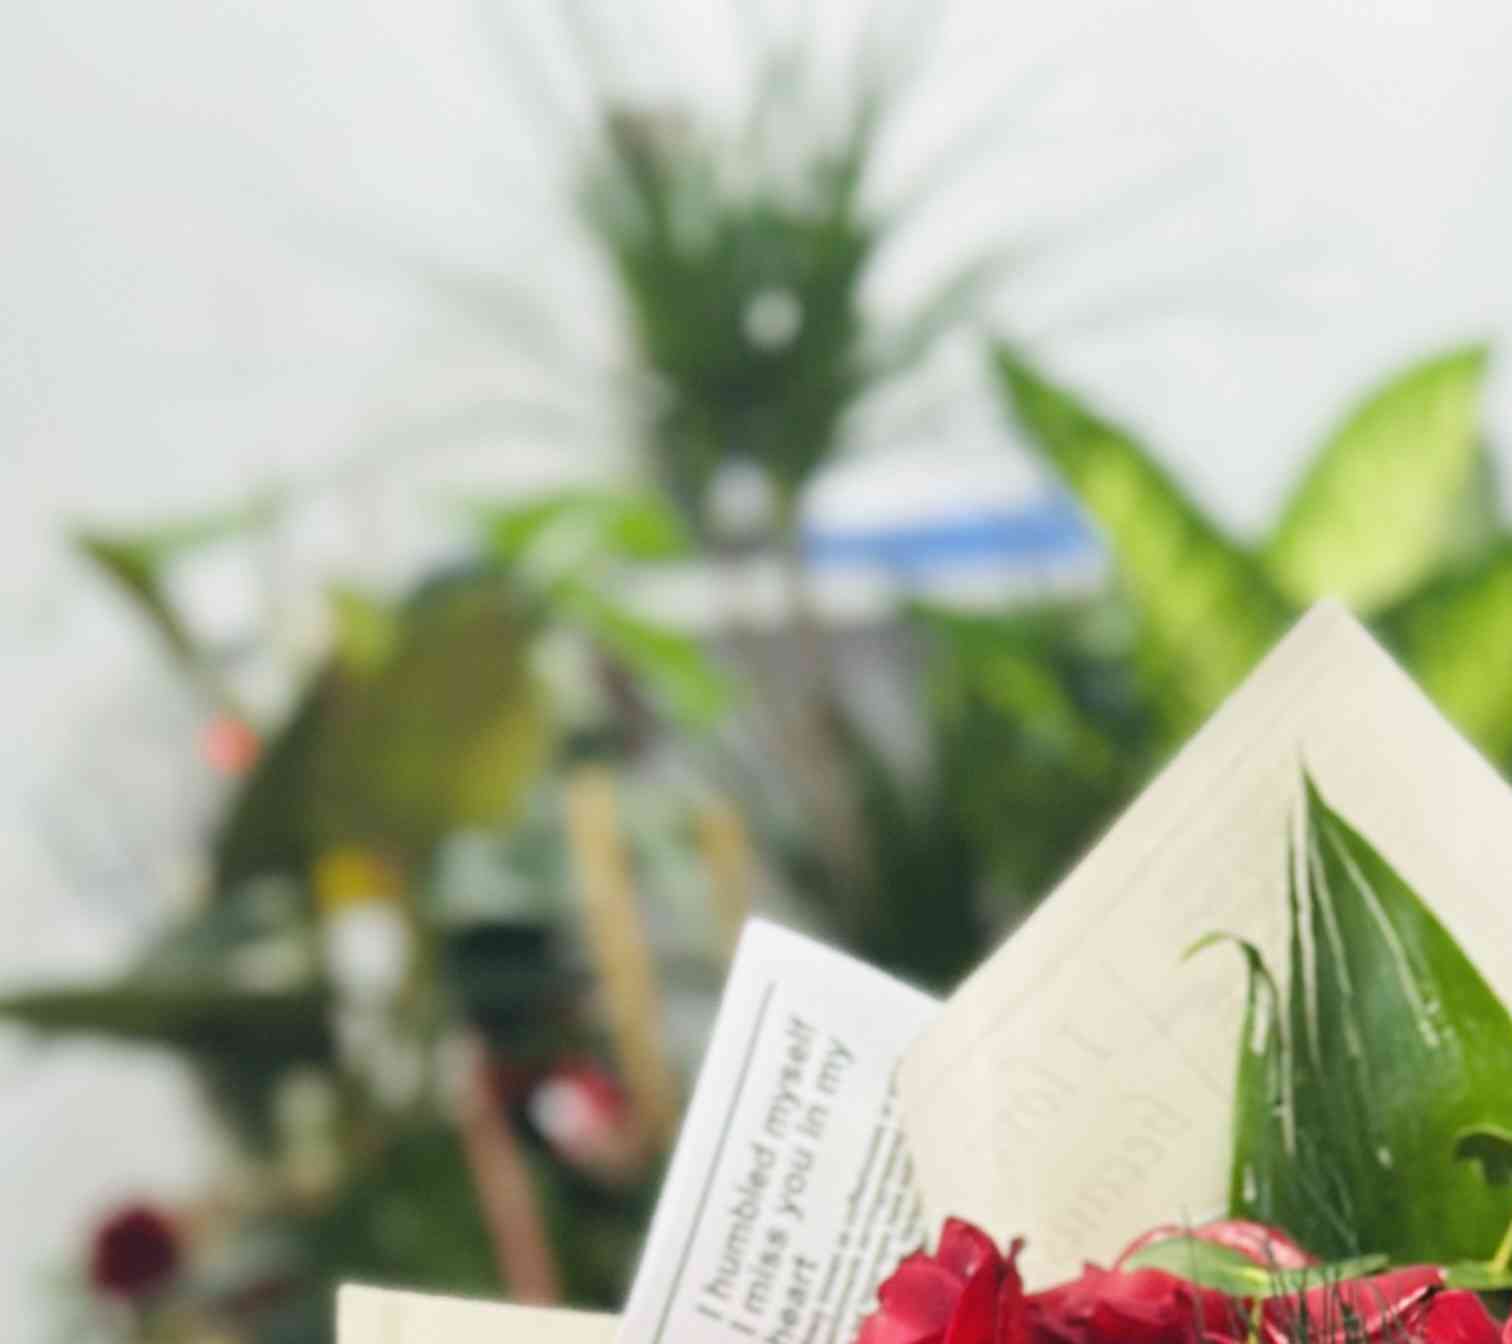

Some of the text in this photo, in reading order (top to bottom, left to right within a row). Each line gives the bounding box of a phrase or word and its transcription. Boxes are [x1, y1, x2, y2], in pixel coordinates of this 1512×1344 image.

[694, 1012, 819, 1321] I humbled myself
[742, 1226, 789, 1318] miss
[774, 1145, 817, 1222] you
[796, 1101, 832, 1141] in
[815, 1034, 858, 1096] my
